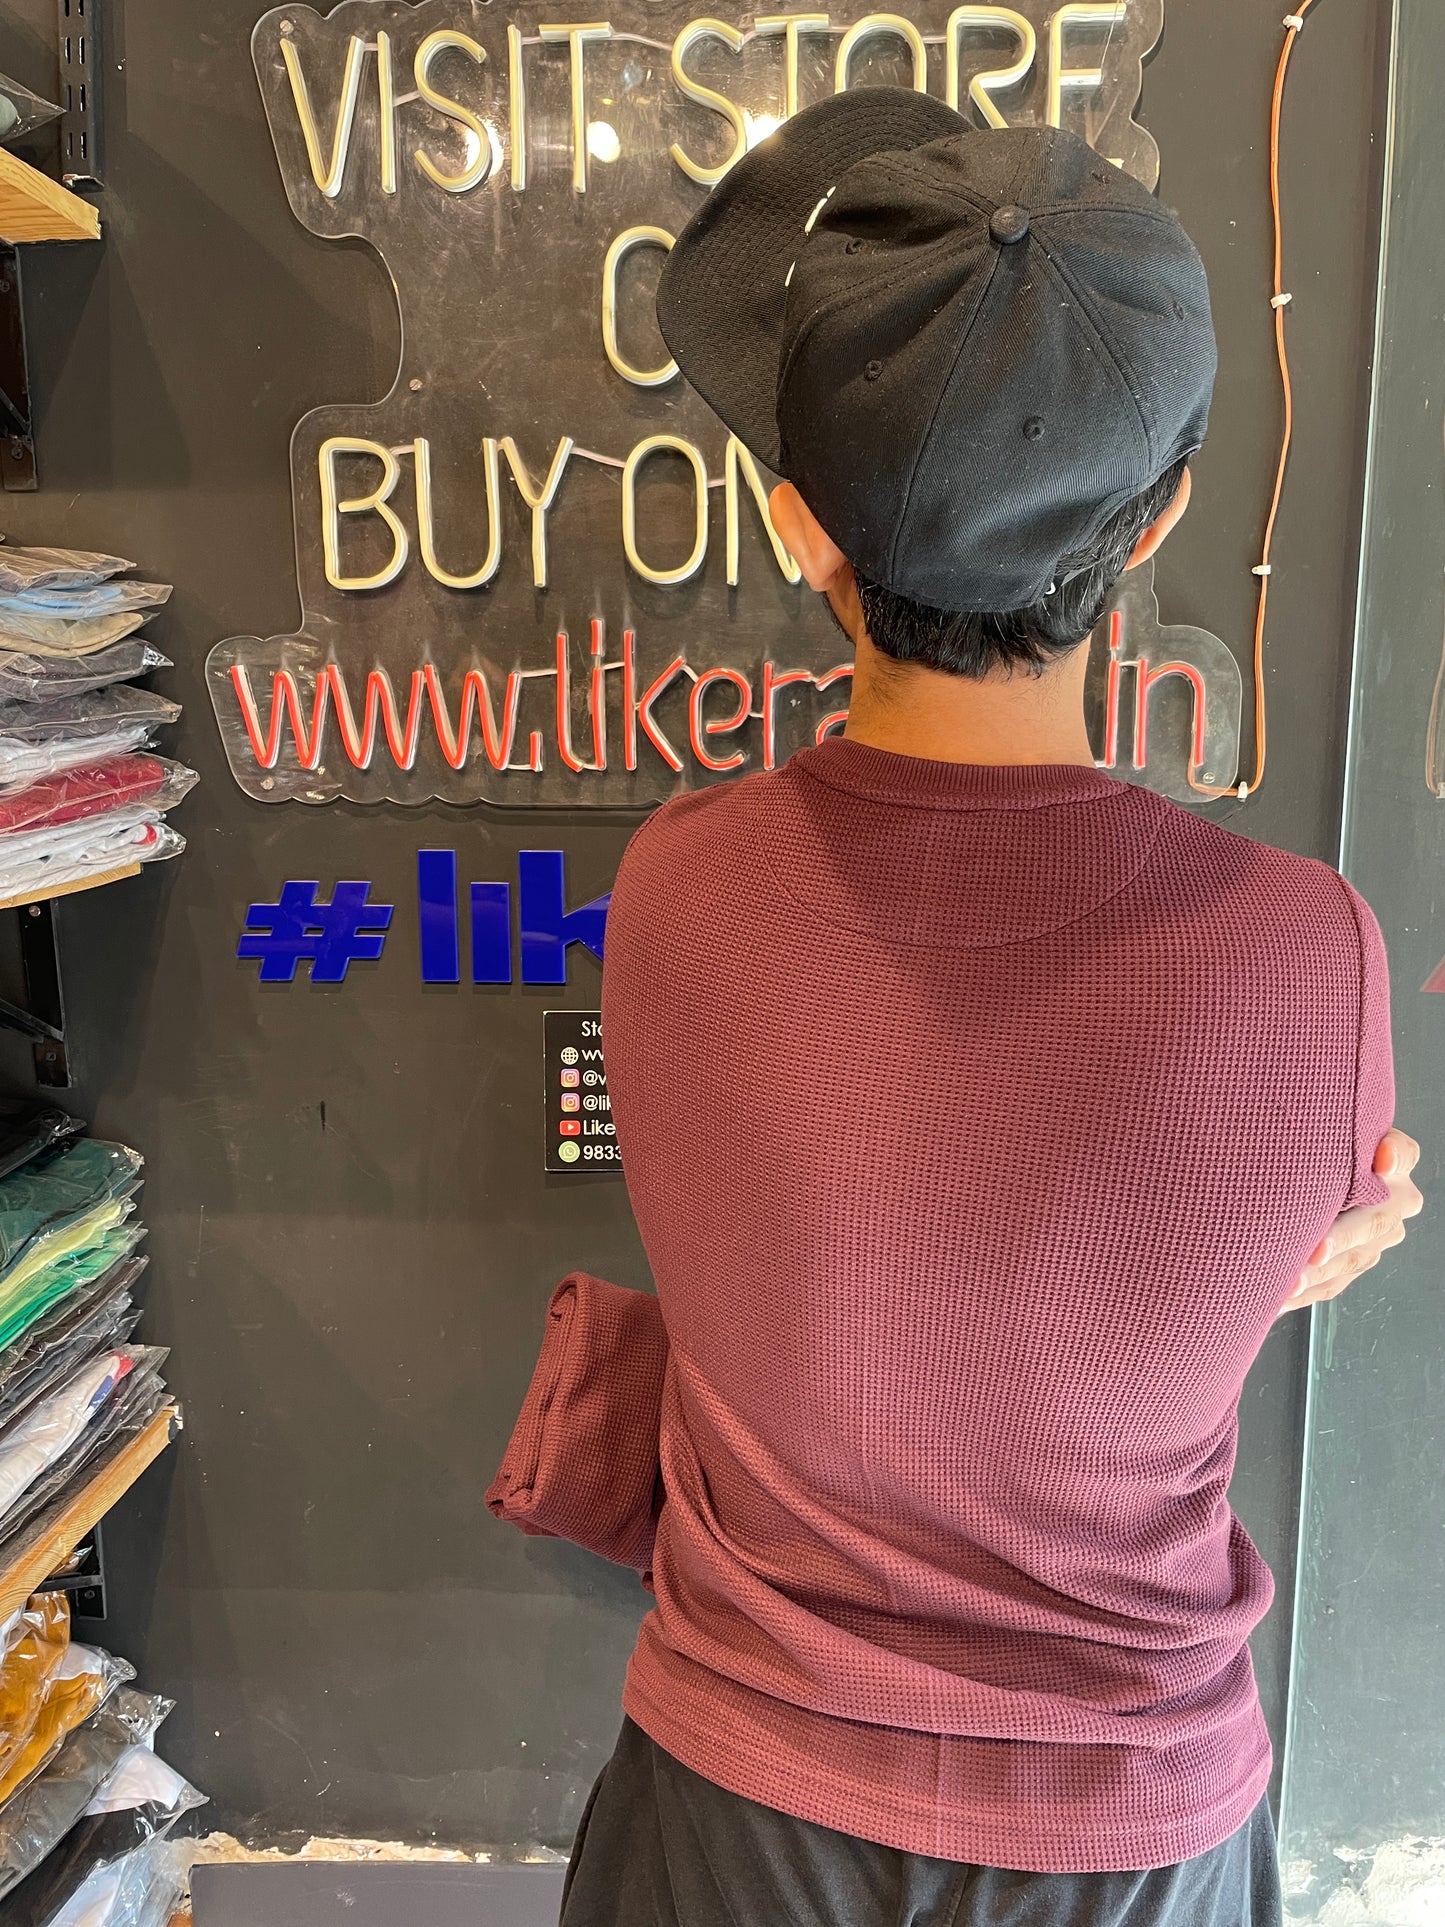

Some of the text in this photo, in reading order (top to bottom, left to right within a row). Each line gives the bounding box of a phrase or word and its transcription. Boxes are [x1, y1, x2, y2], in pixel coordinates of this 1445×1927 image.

[280, 22, 613, 197] VISIT
[318, 432, 802, 590] BUY ON
[236, 849, 614, 985] #lik
[582, 1069, 607, 1086] @v
[582, 1094, 612, 1111] @lik
[583, 1144, 622, 1161] 9833
